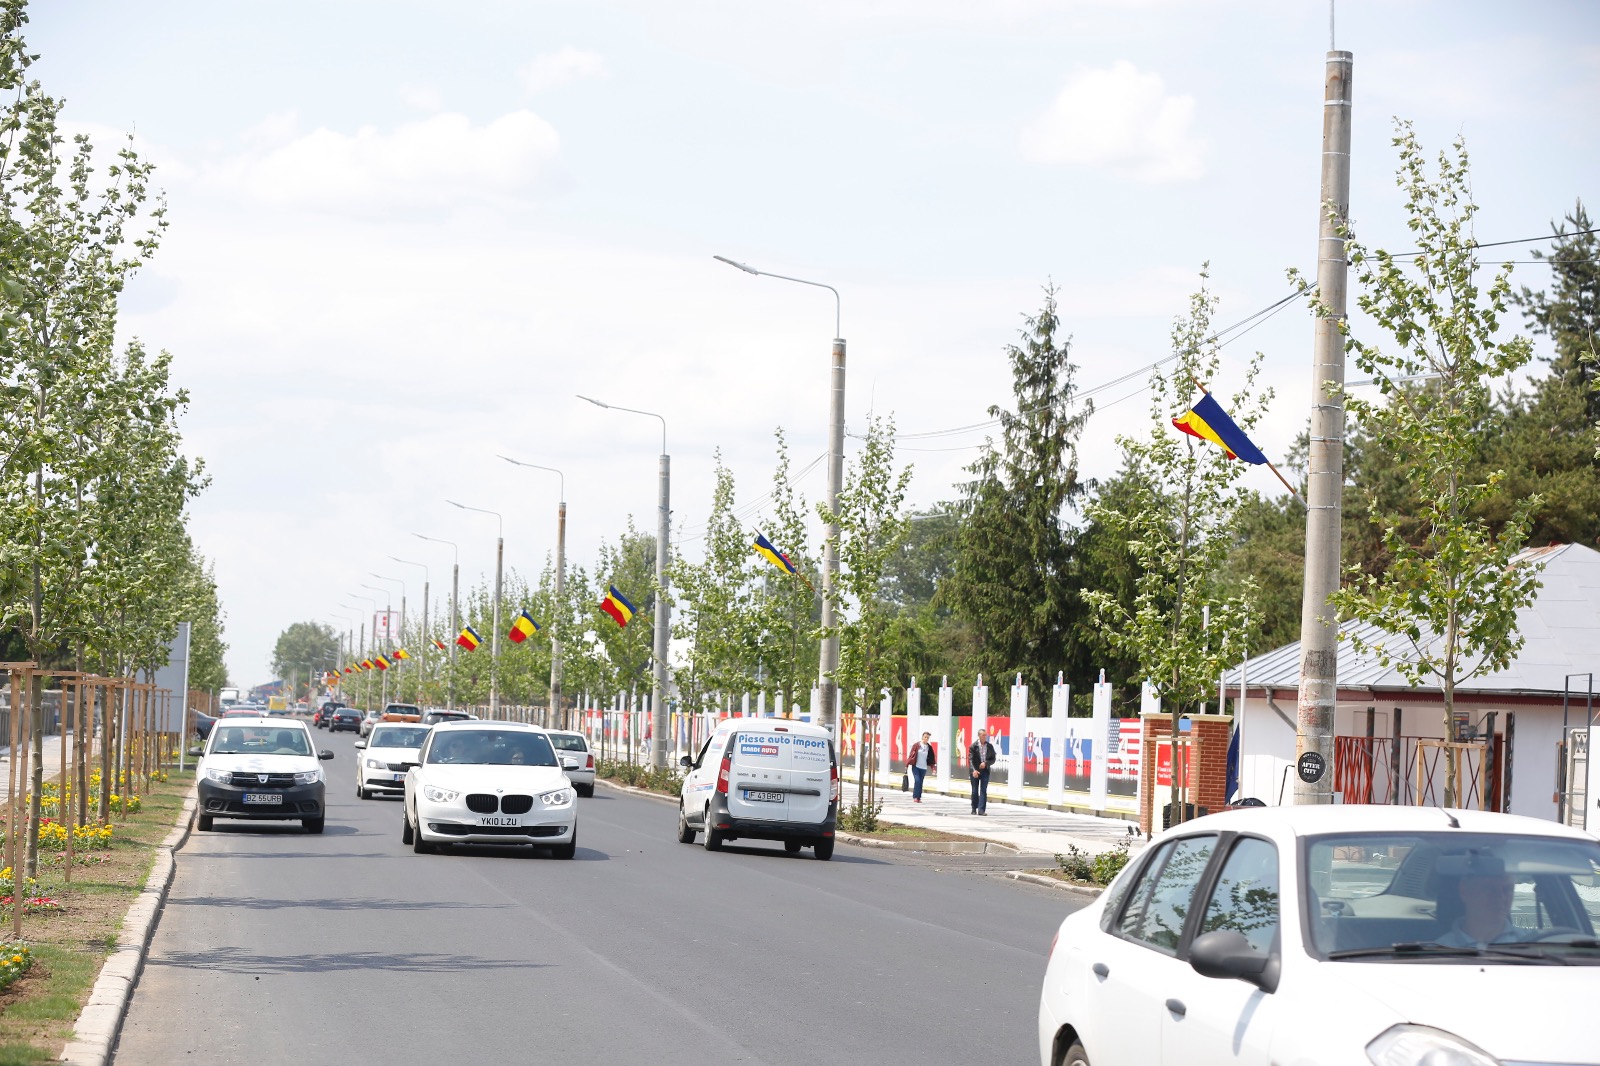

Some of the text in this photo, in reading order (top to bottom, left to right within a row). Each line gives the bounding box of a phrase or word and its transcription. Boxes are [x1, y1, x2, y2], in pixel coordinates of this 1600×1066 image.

[739, 734, 825, 748] Piese auto import
[500, 817, 517, 826] LZU
